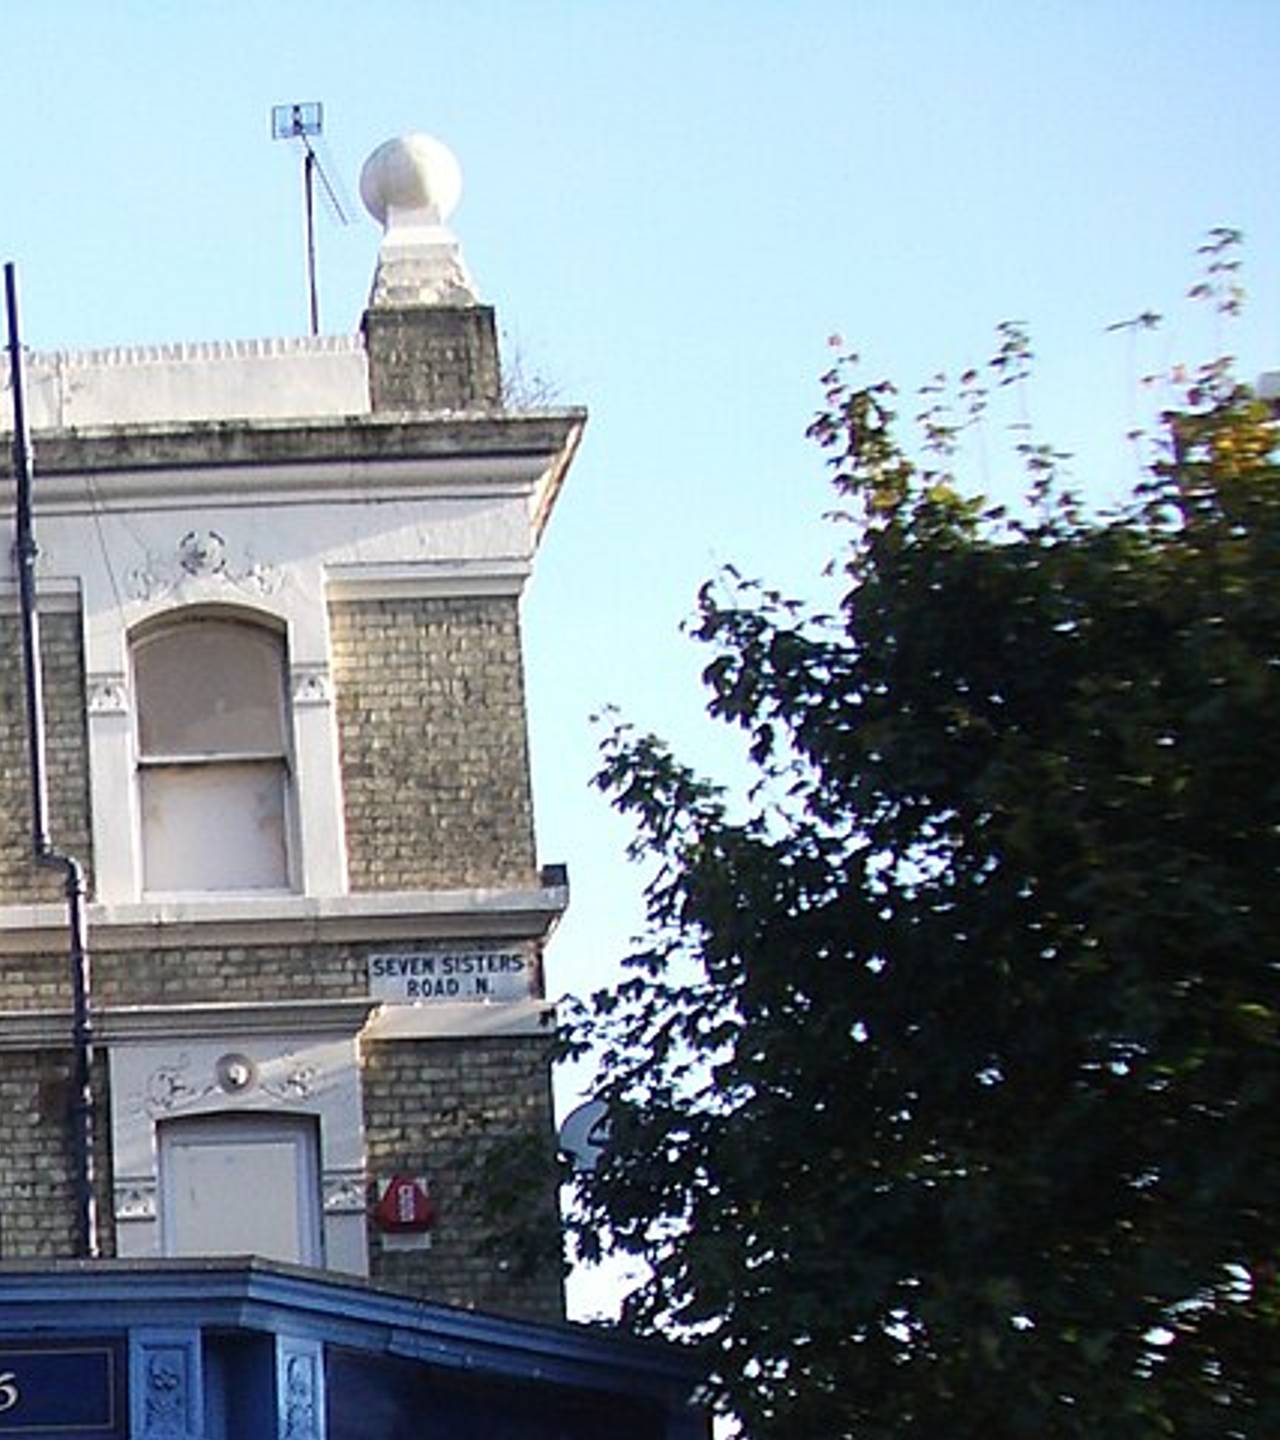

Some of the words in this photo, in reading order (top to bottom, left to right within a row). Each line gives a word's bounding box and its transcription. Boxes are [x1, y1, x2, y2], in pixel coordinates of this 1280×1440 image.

[372, 957, 435, 977] SEVEN
[441, 953, 525, 976] SISTERS
[406, 979, 459, 998] ROAD
